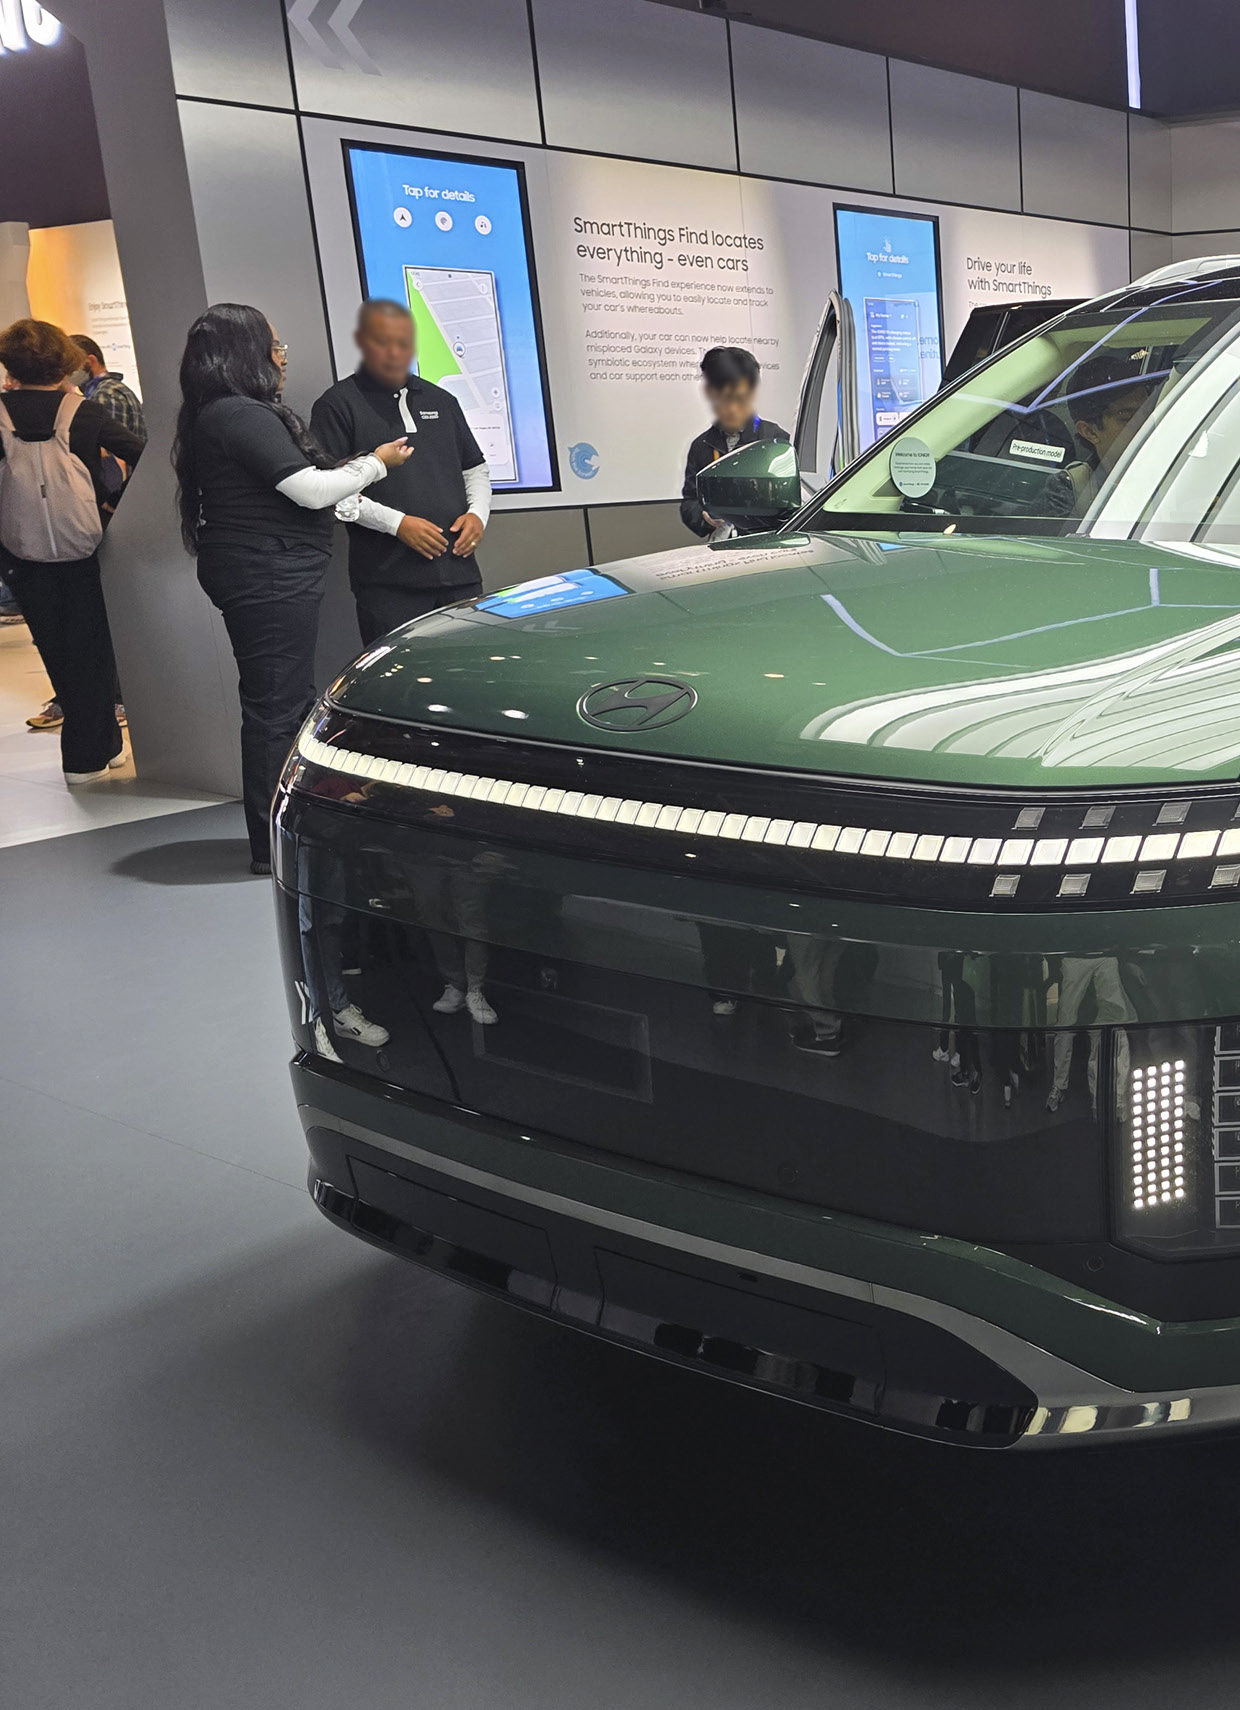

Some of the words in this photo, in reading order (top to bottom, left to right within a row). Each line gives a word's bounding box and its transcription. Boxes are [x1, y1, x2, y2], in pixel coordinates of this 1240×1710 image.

[402, 184, 423, 199] Tap
[424, 186, 440, 199] for
[441, 189, 476, 203] details
[573, 216, 675, 246] SmartThings
[678, 227, 709, 245] Find
[711, 230, 764, 250] locates
[576, 244, 664, 270] everything
[677, 253, 714, 269] even
[717, 256, 749, 272] cars
[866, 252, 878, 264] Tap
[879, 253, 888, 263] for
[889, 254, 909, 265] details
[966, 257, 992, 271] Drive
[995, 263, 1017, 276] your
[1018, 261, 1033, 276] life
[579, 273, 596, 283] The
[597, 274, 651, 289] SmartThings
[652, 278, 669, 288] Find
[671, 280, 716, 291] experience
[717, 284, 734, 293] now
[735, 285, 765, 295] extends
[766, 286, 774, 295] to
[968, 277, 991, 291] with
[992, 279, 1052, 299] SmartThings
[580, 287, 618, 300] vehicles,
[619, 290, 655, 303] allowing
[656, 294, 672, 304] you
[672, 293, 682, 303] to
[683, 294, 706, 305] easily
[707, 295, 732, 305] locate
[733, 297, 748, 306] and
[749, 298, 769, 307] track
[582, 302, 601, 313] your
[603, 302, 625, 313] car's
[627, 304, 684, 316] whereabouts.
[585, 329, 637, 342] Additionally,
[638, 332, 657, 343] your
[658, 333, 672, 341] car
[674, 333, 690, 342] can
[691, 334, 709, 343] now
[710, 334, 727, 345] help
[728, 336, 752, 345] locate
[753, 336, 779, 347] nearby
[586, 343, 632, 355] misplaced
[633, 344, 663, 356] Galaxy
[664, 345, 697, 355] devices.
[588, 357, 630, 368] symbiotic
[631, 358, 678, 369] ecosystem
[590, 371, 607, 381] and
[608, 372, 623, 381] car
[625, 372, 658, 383] support
[659, 372, 681, 381] each
[1012, 443, 1045, 457] Pre-production
[1045, 447, 1063, 459] model
